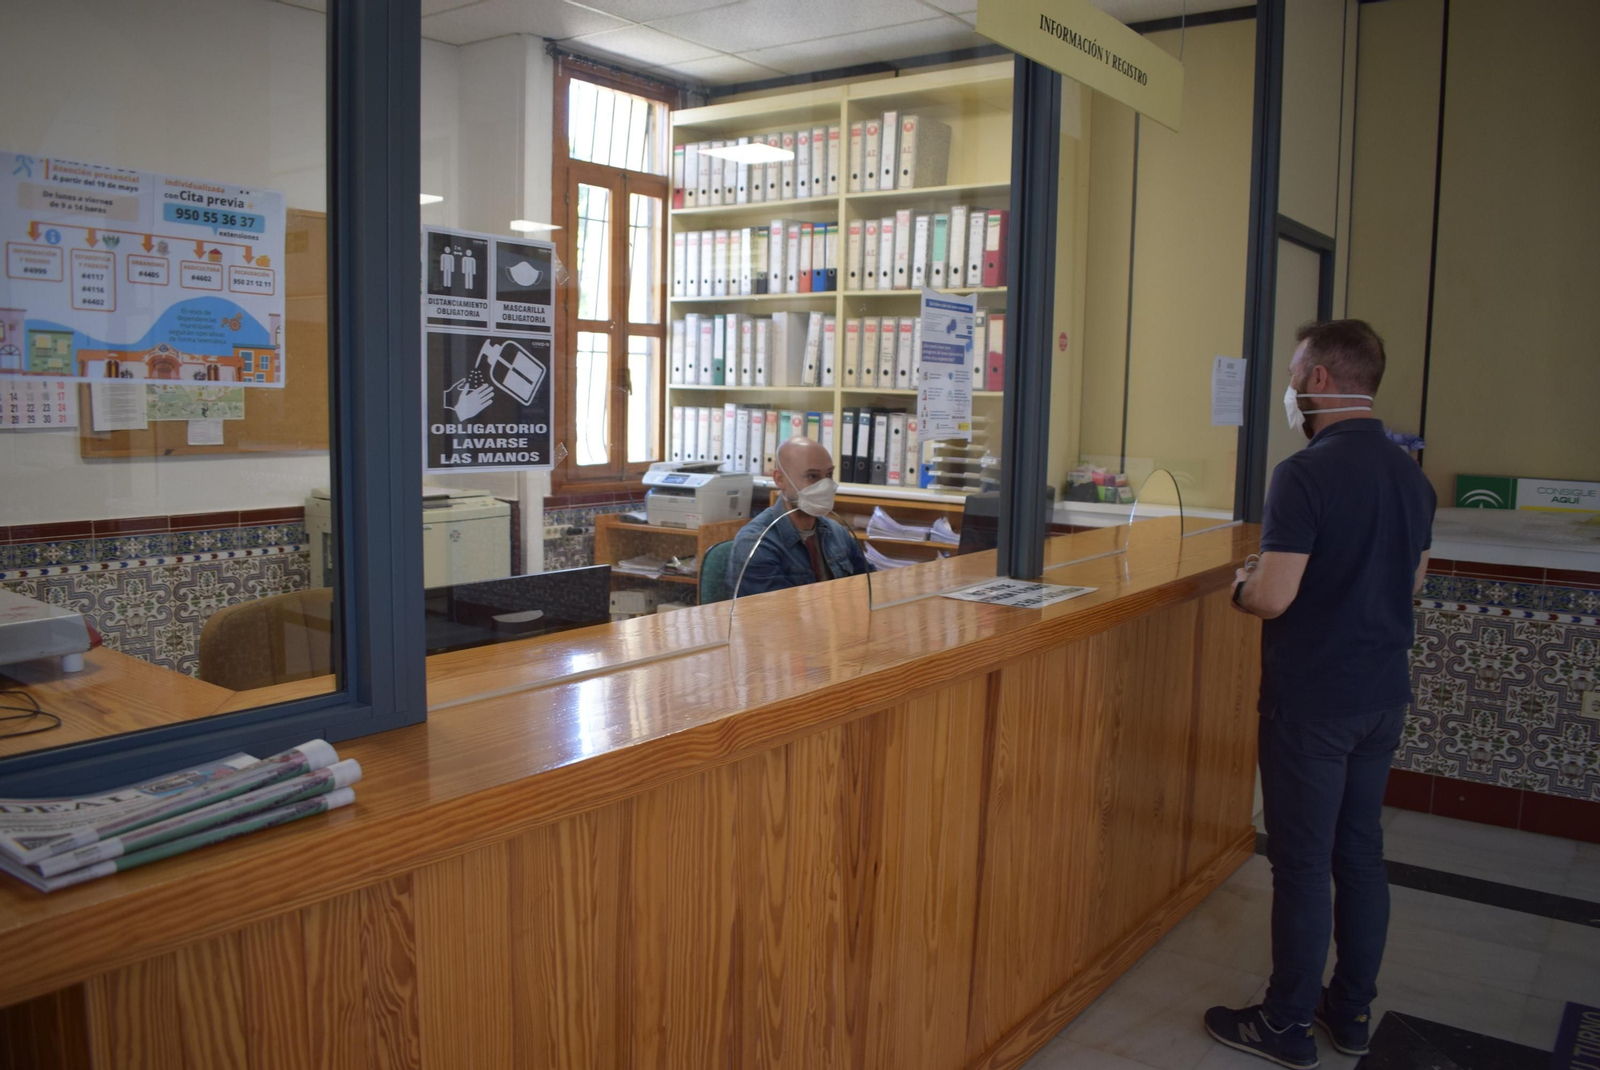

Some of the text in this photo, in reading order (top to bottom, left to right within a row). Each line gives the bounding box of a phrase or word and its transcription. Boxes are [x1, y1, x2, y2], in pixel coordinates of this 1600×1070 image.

[1040, 14, 1148, 86] INFORMACIÓN Y REGISTRO
[53, 164, 91, 176] Atención
[94, 171, 139, 183] presencial
[60, 176, 81, 184] partir
[118, 184, 139, 193] mayo
[165, 179, 225, 194] Individualizada
[55, 192, 76, 201] lunes
[85, 196, 113, 206] viernes
[180, 190, 204, 203] Cita
[207, 196, 245, 208] previa
[85, 206, 107, 214] horas
[176, 208, 256, 228] 950 55 36 37
[219, 231, 260, 240] extensiones
[428, 297, 488, 310] DISTANCIAMIENTO
[503, 304, 545, 314] MASCARILLA
[436, 307, 480, 318] OBLIGATORIA
[502, 313, 546, 324] OBLIGATORIA
[10, 392, 18, 401] 14
[10, 404, 18, 412] 21
[27, 404, 35, 412] 22
[42, 404, 51, 412] 23
[43, 414, 52, 423] 30
[431, 424, 548, 434] OBLIGATORIO
[453, 438, 529, 449] LAVARSE
[440, 452, 540, 464] LAS MANOS
[1537, 486, 1596, 498] CONSIGUE
